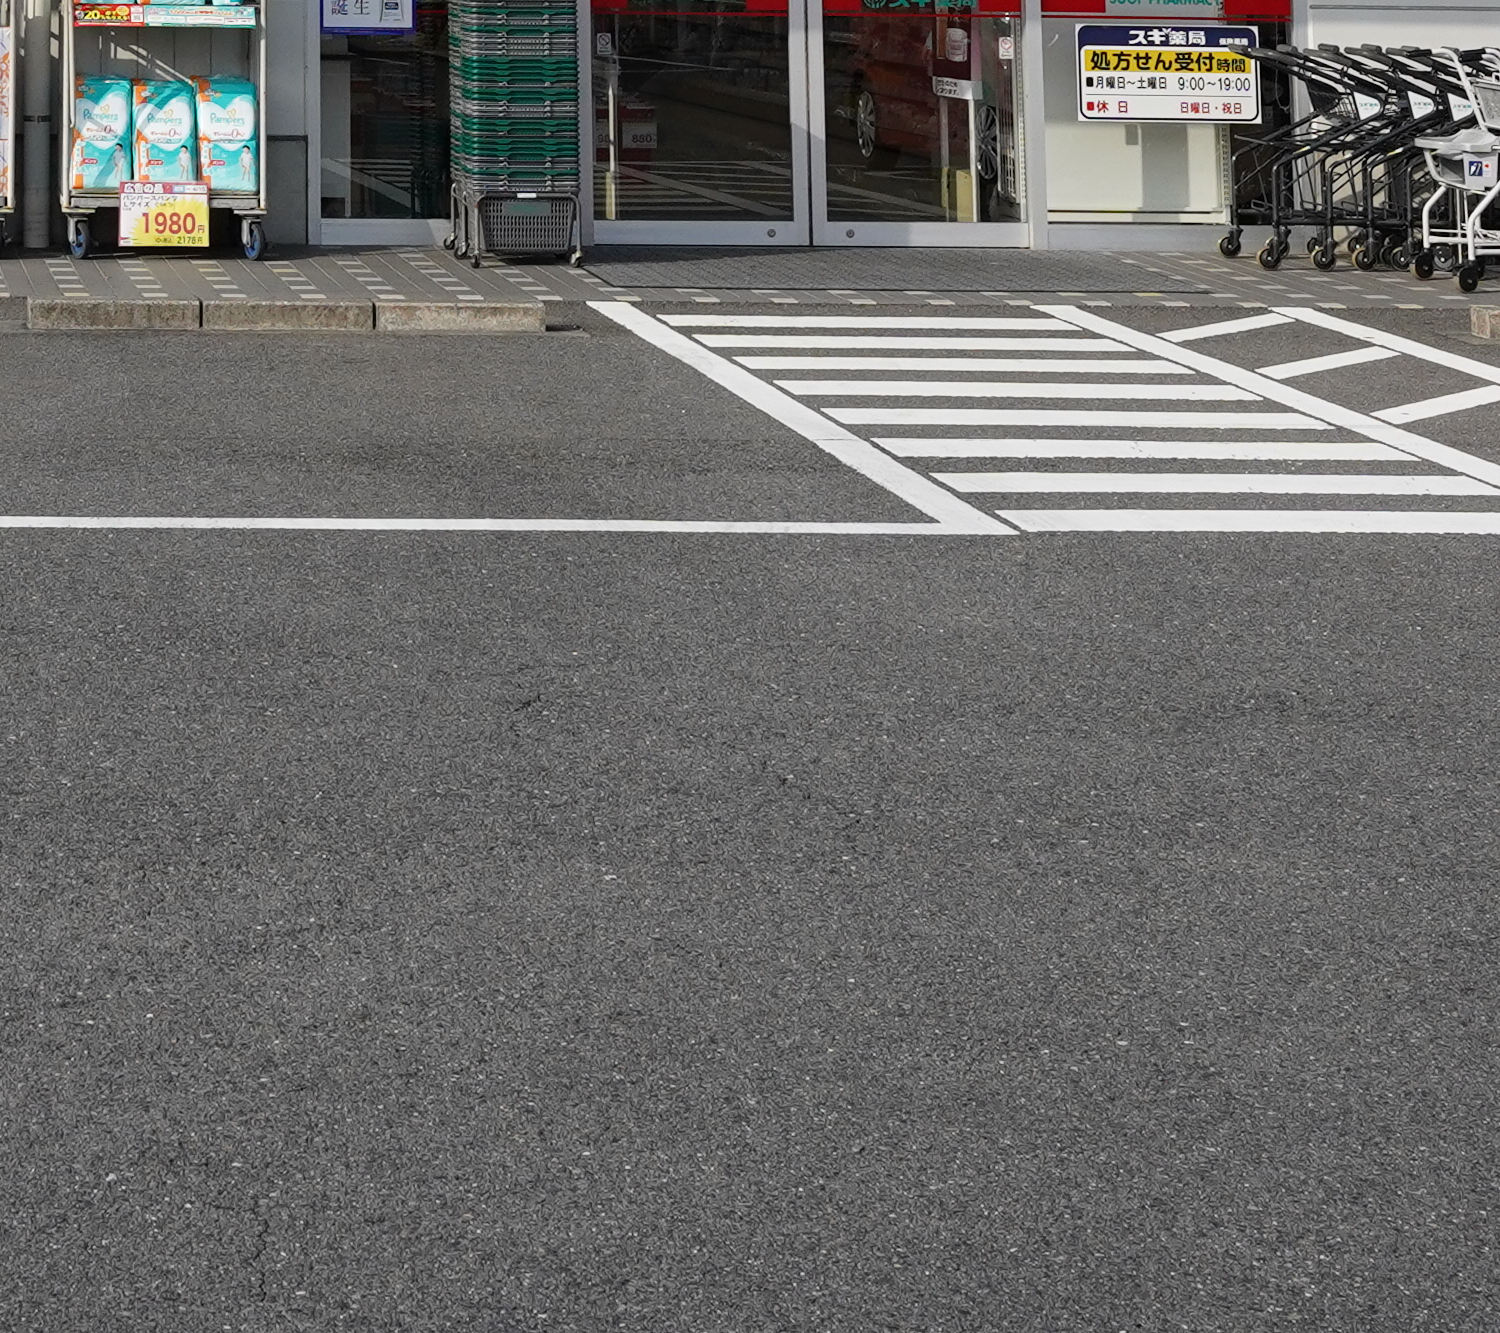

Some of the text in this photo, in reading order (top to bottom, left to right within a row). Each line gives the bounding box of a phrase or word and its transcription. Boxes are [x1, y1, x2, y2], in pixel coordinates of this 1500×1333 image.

[1128, 27, 1206, 45] スギ薬局
[1180, 102, 1242, 114] 日曜日・祝日
[83, 109, 118, 122] Pampers
[147, 112, 182, 124] Pampers
[210, 113, 245, 125] Pampers
